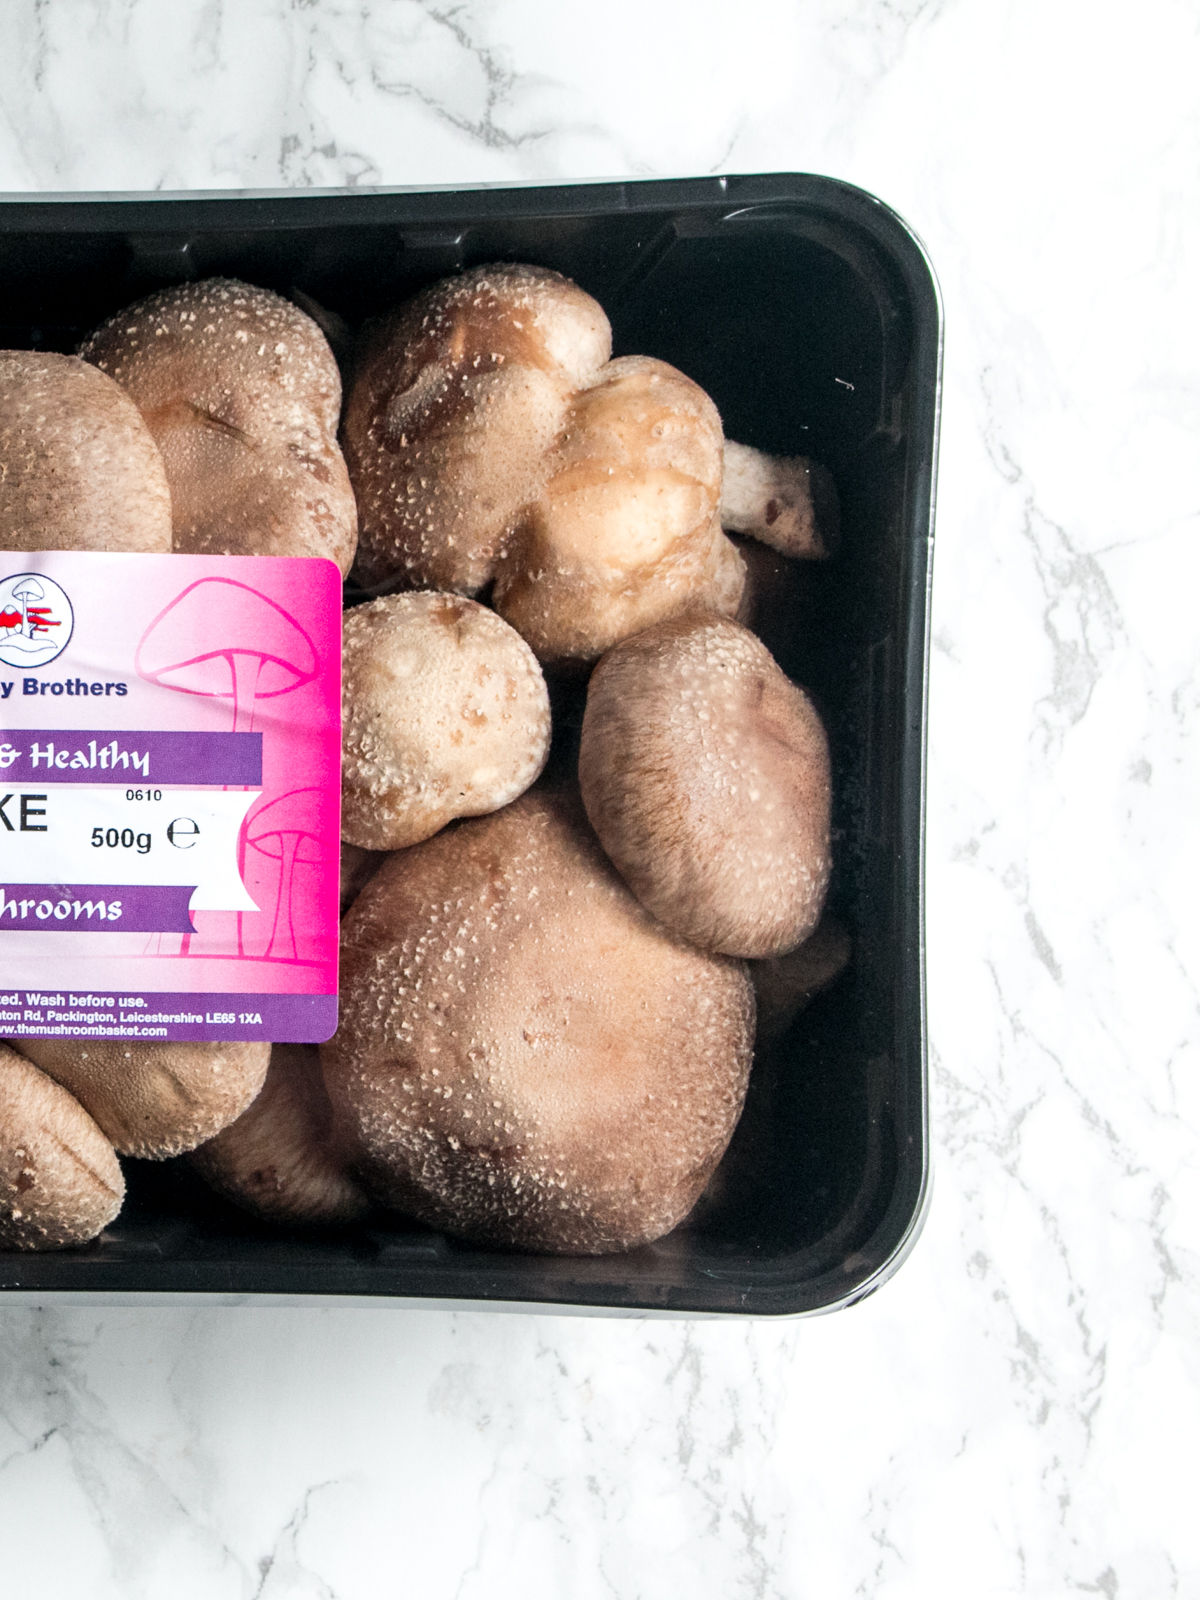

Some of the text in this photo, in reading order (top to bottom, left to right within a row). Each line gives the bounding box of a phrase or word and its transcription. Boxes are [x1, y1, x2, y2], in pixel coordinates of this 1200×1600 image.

[22, 678, 128, 697] Brothers
[30, 741, 150, 776] Healthy
[125, 789, 162, 801] 0610
[90, 828, 152, 854] 500g
[26, 993, 65, 1007] Wash
[69, 994, 114, 1008] before
[118, 997, 148, 1008] use.
[24, 1010, 44, 1023] Rd,
[47, 1011, 117, 1025] Packington,
[120, 1011, 203, 1024] Leicestershire
[205, 1013, 235, 1024] LE65
[238, 1013, 262, 1024] 1XA
